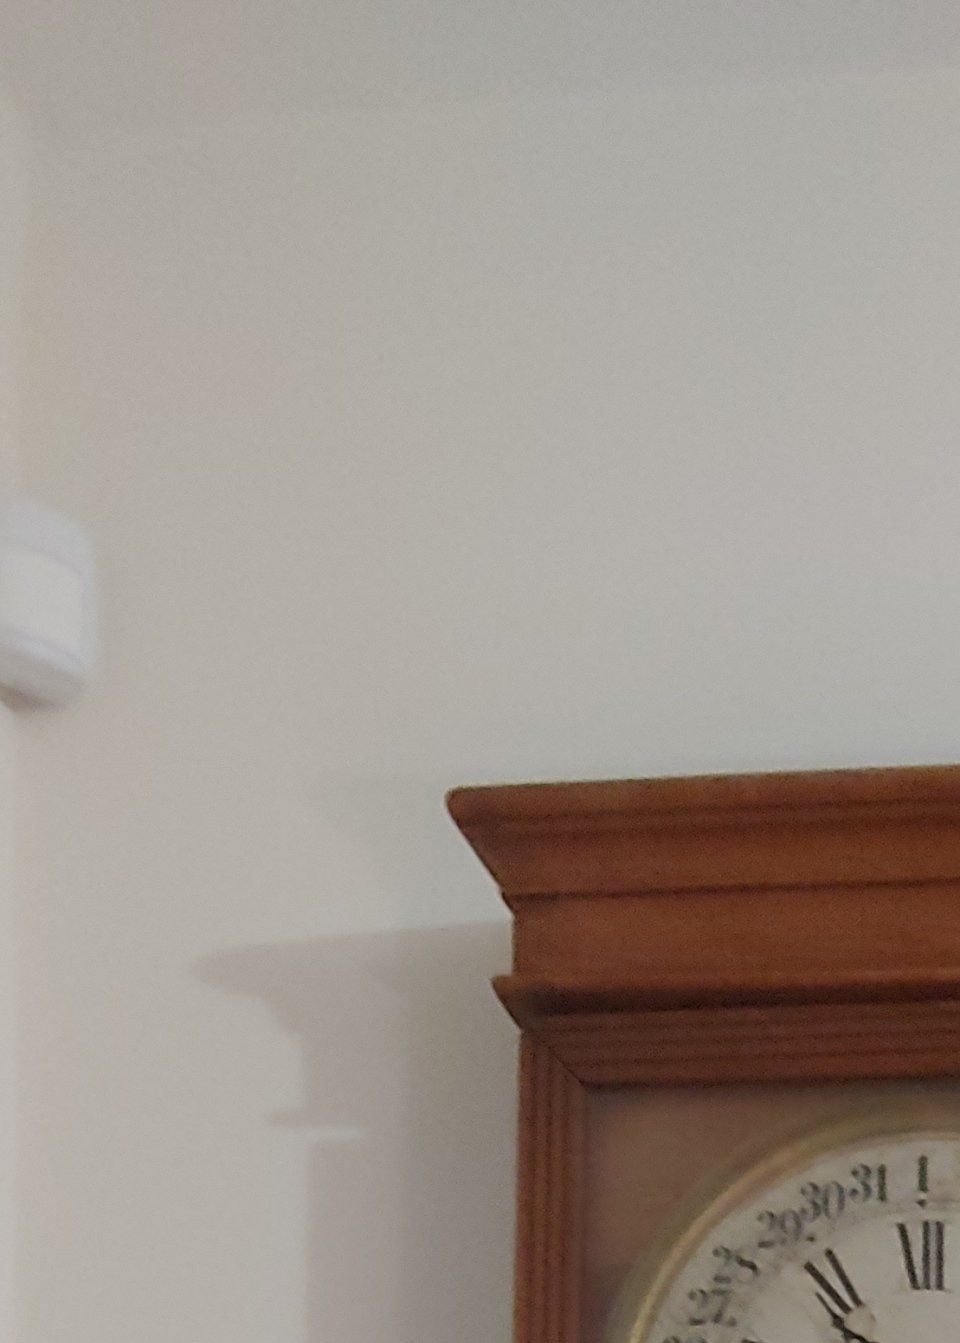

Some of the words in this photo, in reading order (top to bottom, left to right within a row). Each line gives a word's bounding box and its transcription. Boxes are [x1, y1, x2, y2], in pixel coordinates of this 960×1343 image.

[849, 1163, 887, 1201] 31
[918, 1155, 928, 1192] 1
[800, 1180, 846, 1222] 30
[712, 1245, 758, 1285] 28
[688, 1288, 732, 1326] 27
